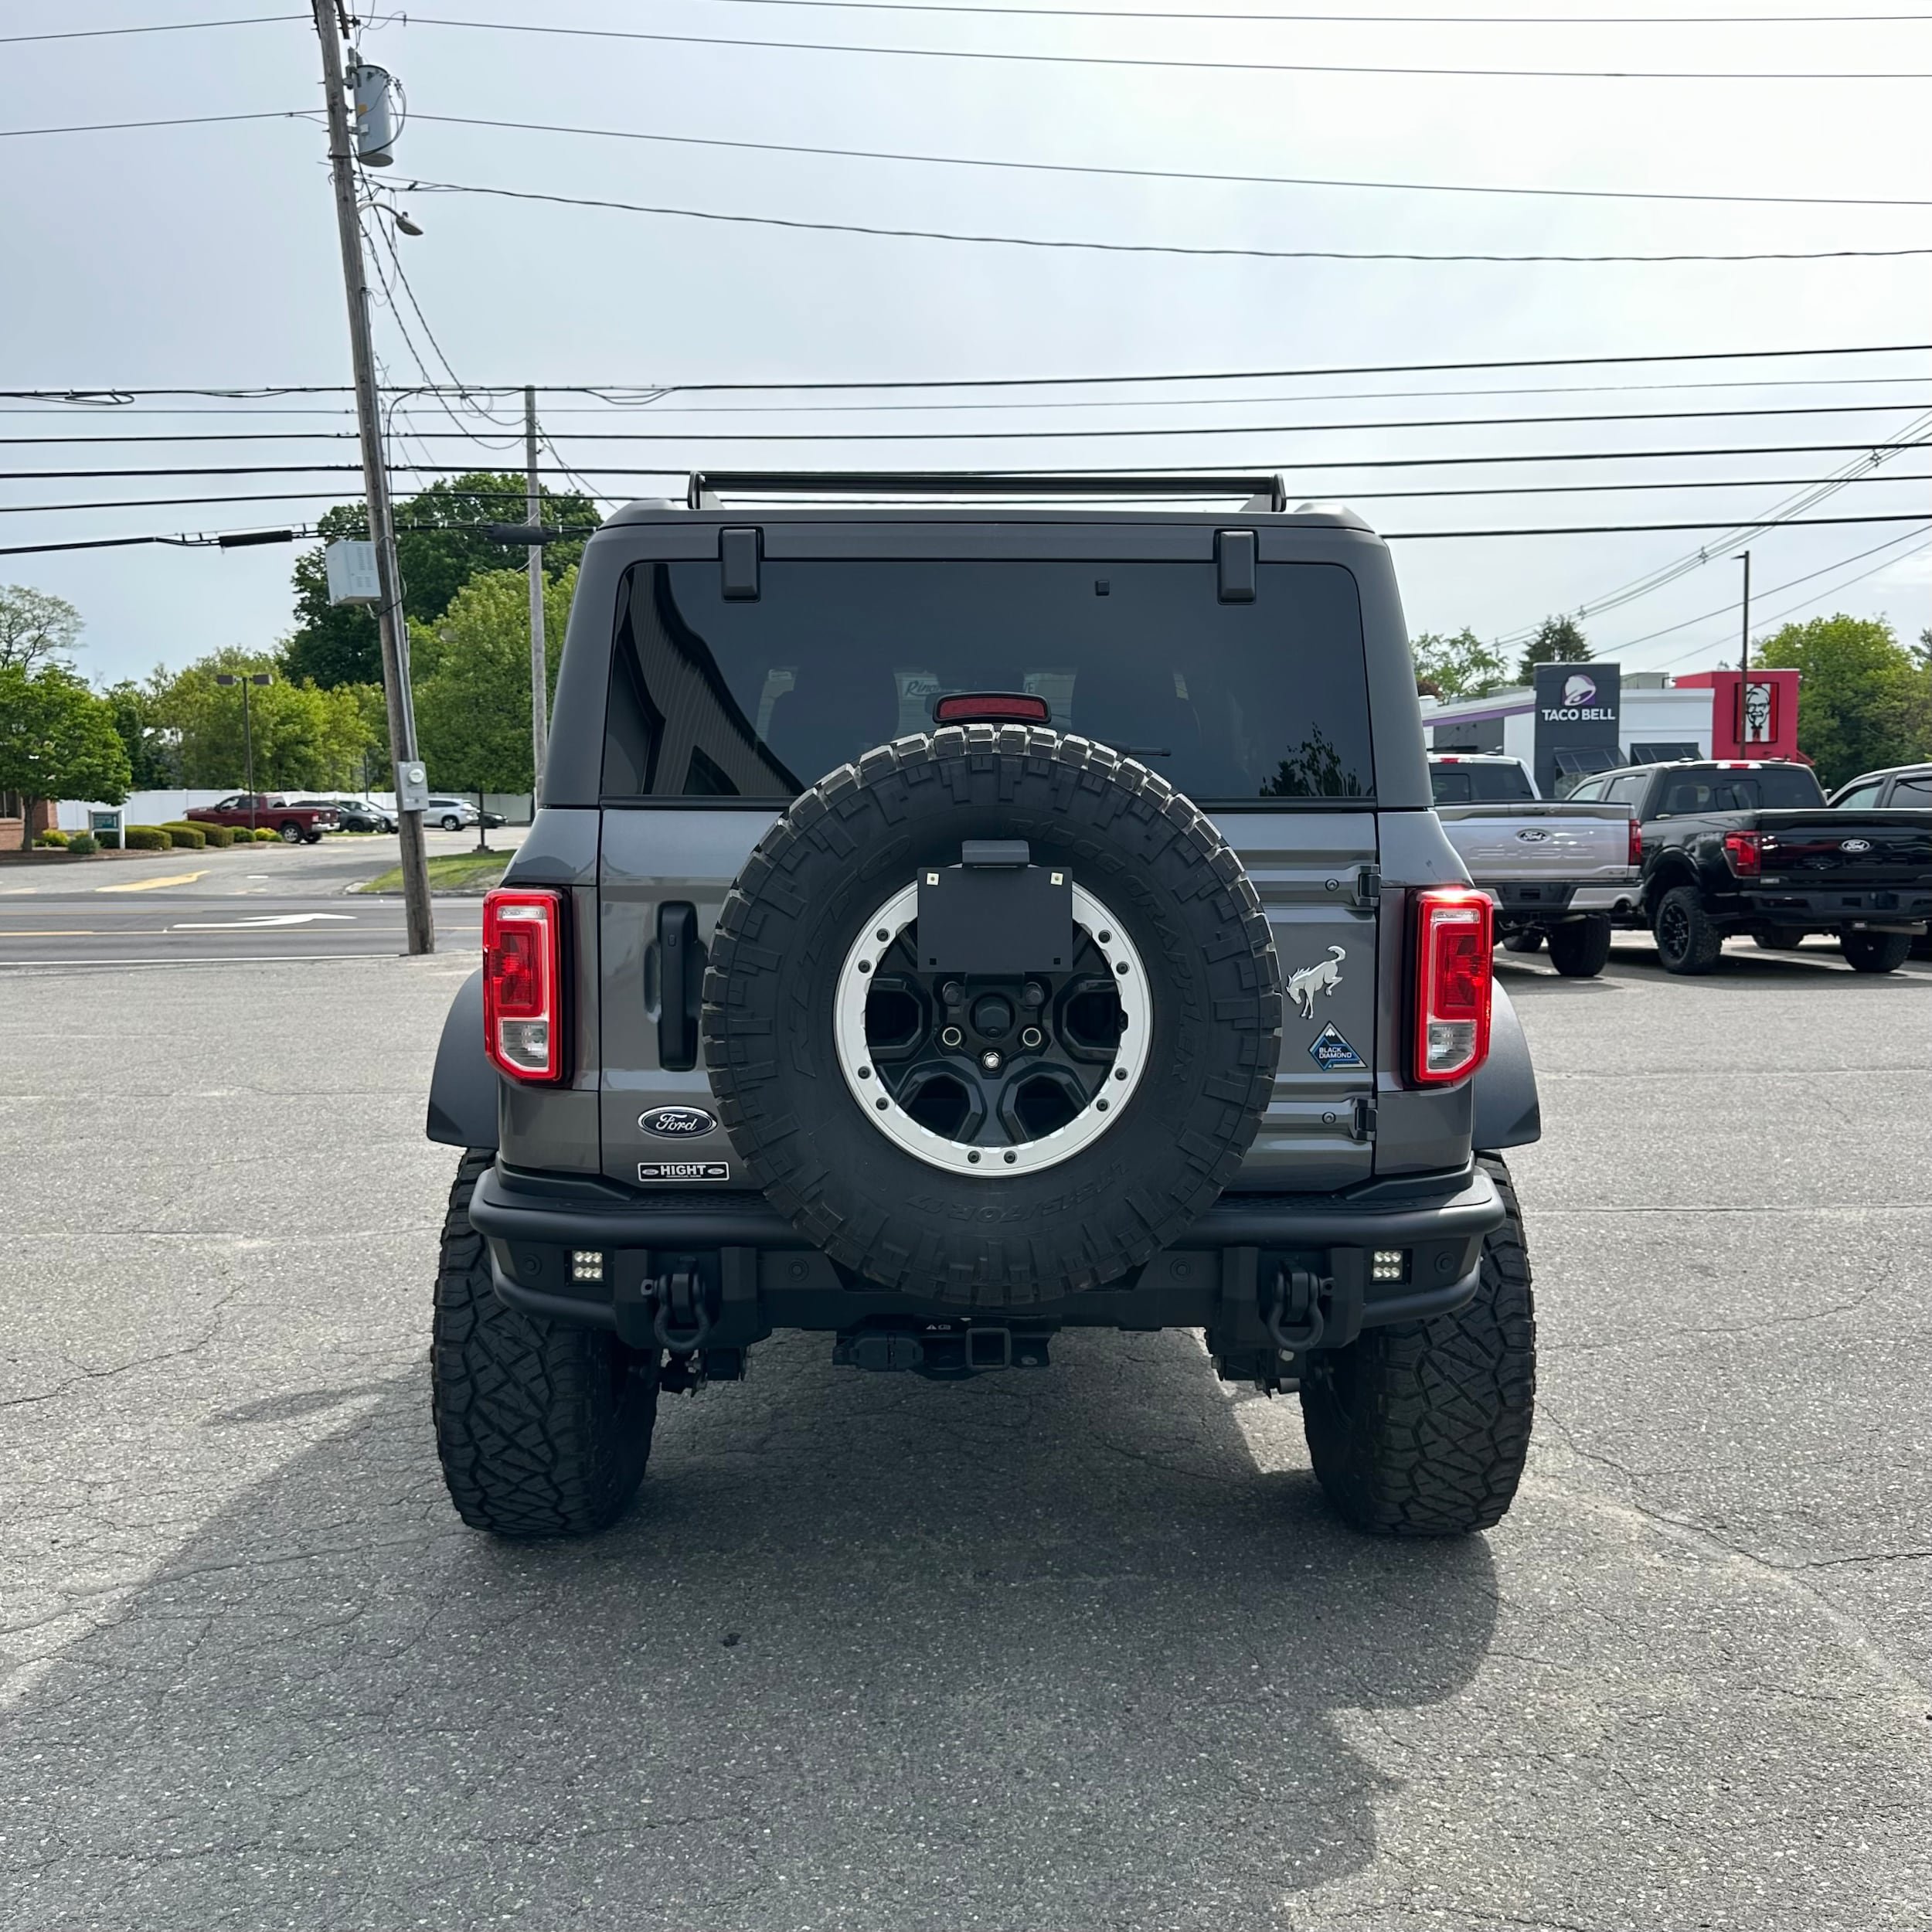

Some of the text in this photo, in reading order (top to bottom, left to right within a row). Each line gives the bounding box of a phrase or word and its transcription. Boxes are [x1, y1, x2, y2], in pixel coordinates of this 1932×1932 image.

[1542, 709, 1616, 721] TACO BELL
[1011, 818, 1196, 1081] RIDGE GRAPPLER
[655, 1113, 698, 1131] Ford
[660, 1165, 706, 1175] HIGHT
